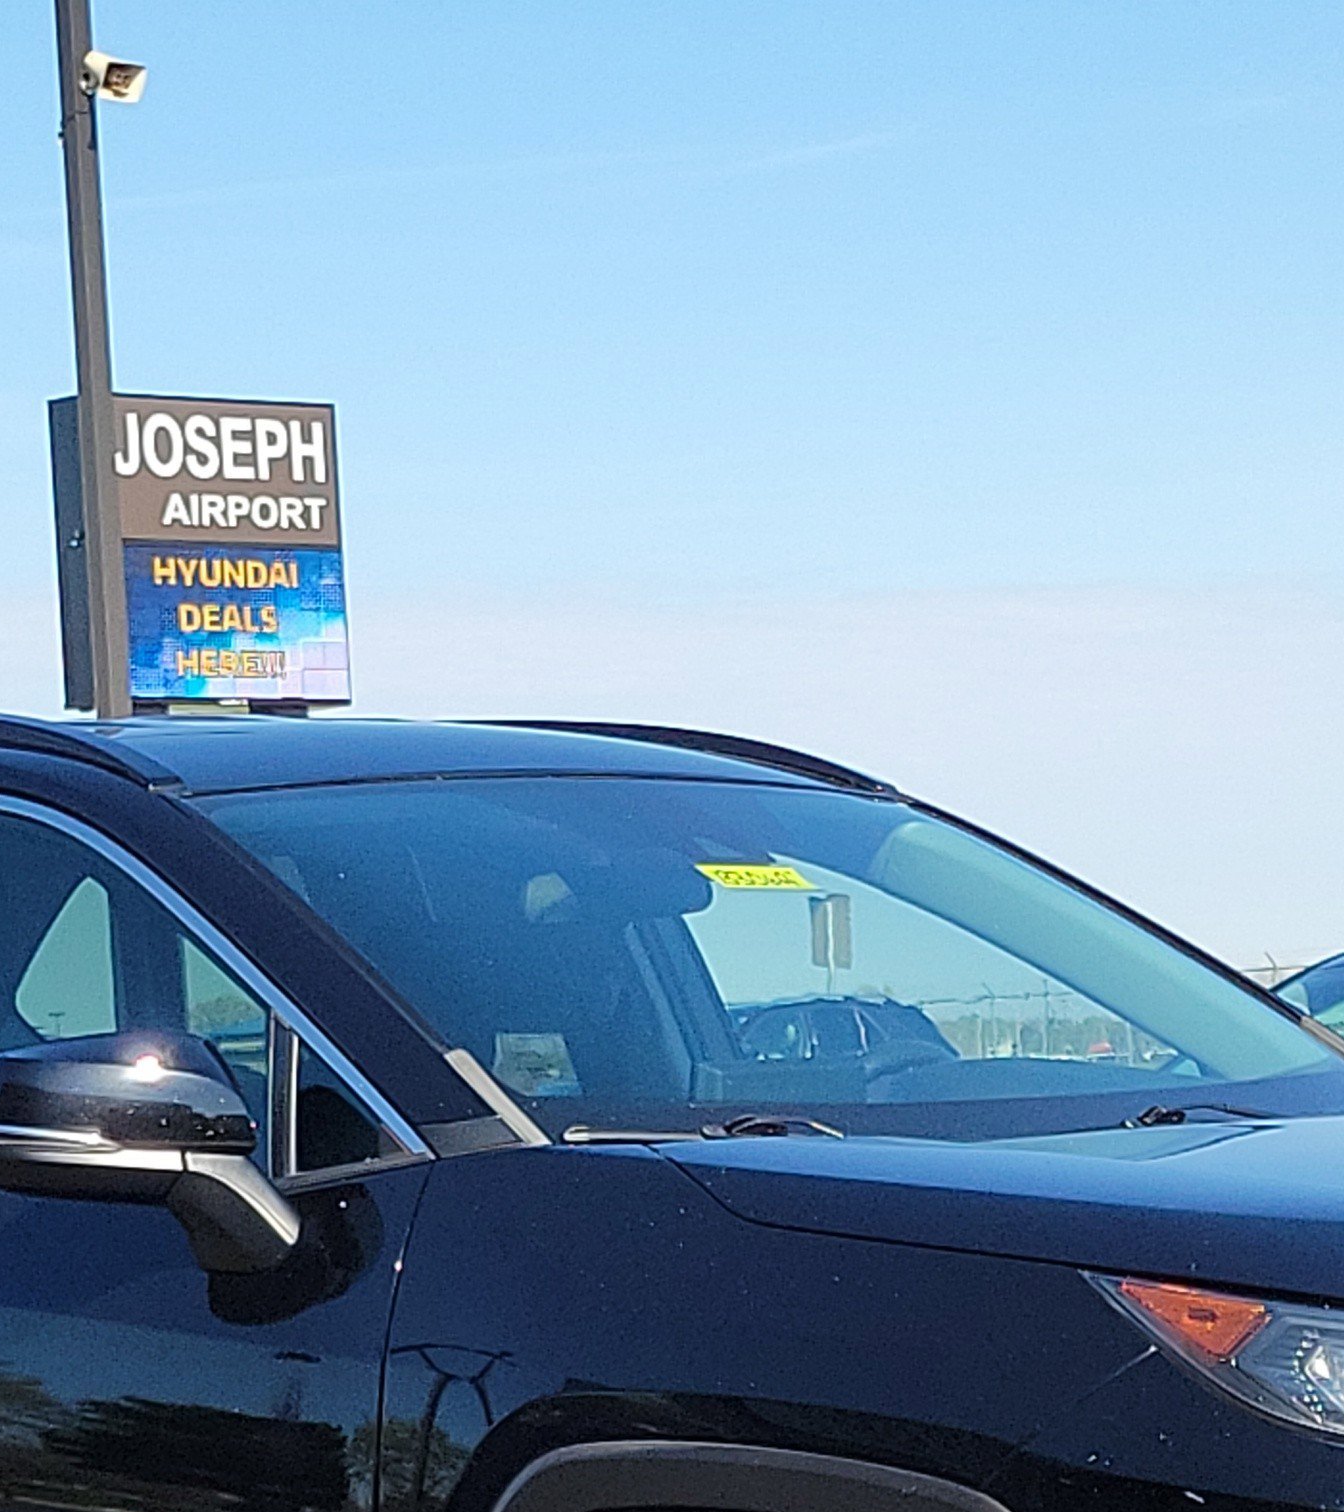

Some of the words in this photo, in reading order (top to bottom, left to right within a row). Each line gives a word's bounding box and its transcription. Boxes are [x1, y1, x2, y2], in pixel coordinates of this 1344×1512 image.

[113, 412, 327, 484] JOSEPH
[162, 492, 327, 530] AIRPORT
[153, 556, 299, 589] HYUNDAI
[178, 603, 279, 633] DEALS
